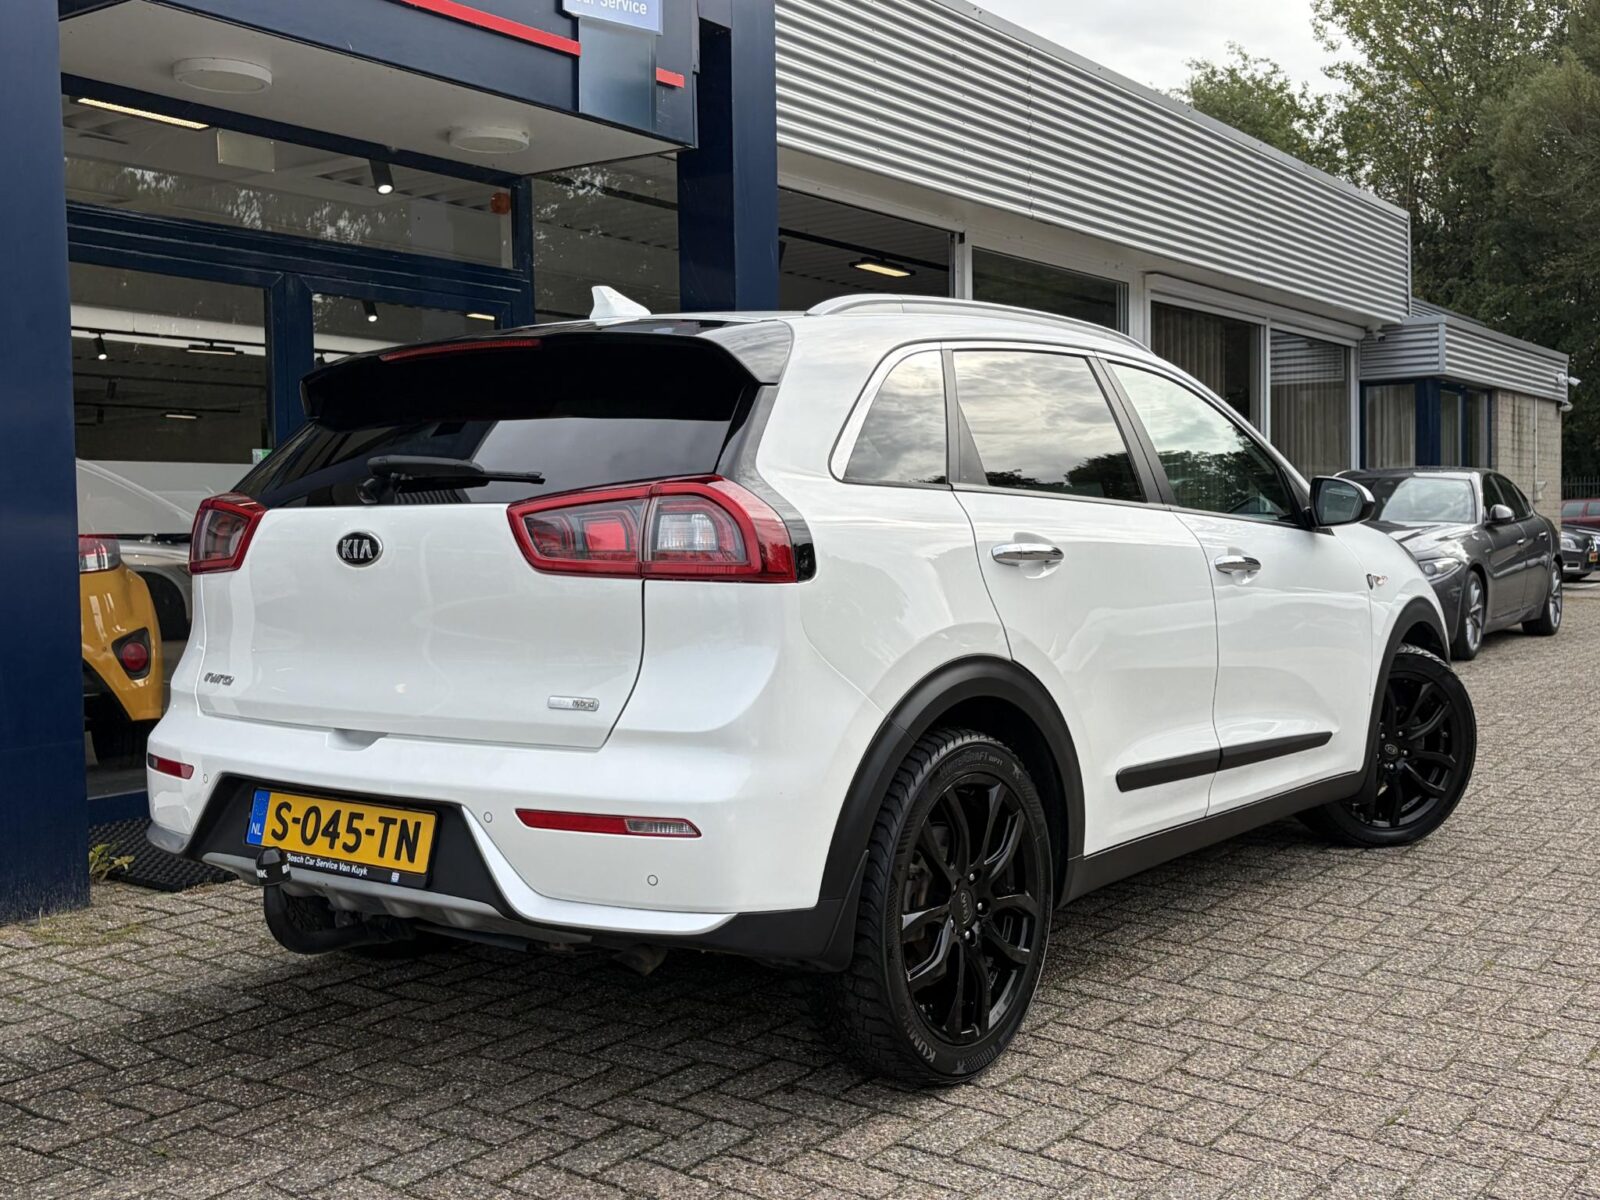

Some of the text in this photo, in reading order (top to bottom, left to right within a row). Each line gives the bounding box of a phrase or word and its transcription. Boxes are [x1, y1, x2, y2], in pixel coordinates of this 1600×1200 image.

[342, 539, 373, 559] KIA
[250, 822, 262, 836] NL
[271, 802, 421, 863] S-045-TN
[305, 856, 315, 866] Car
[316, 858, 338, 871] Service
[340, 861, 351, 873] Van
[351, 864, 368, 877] Kuyk
